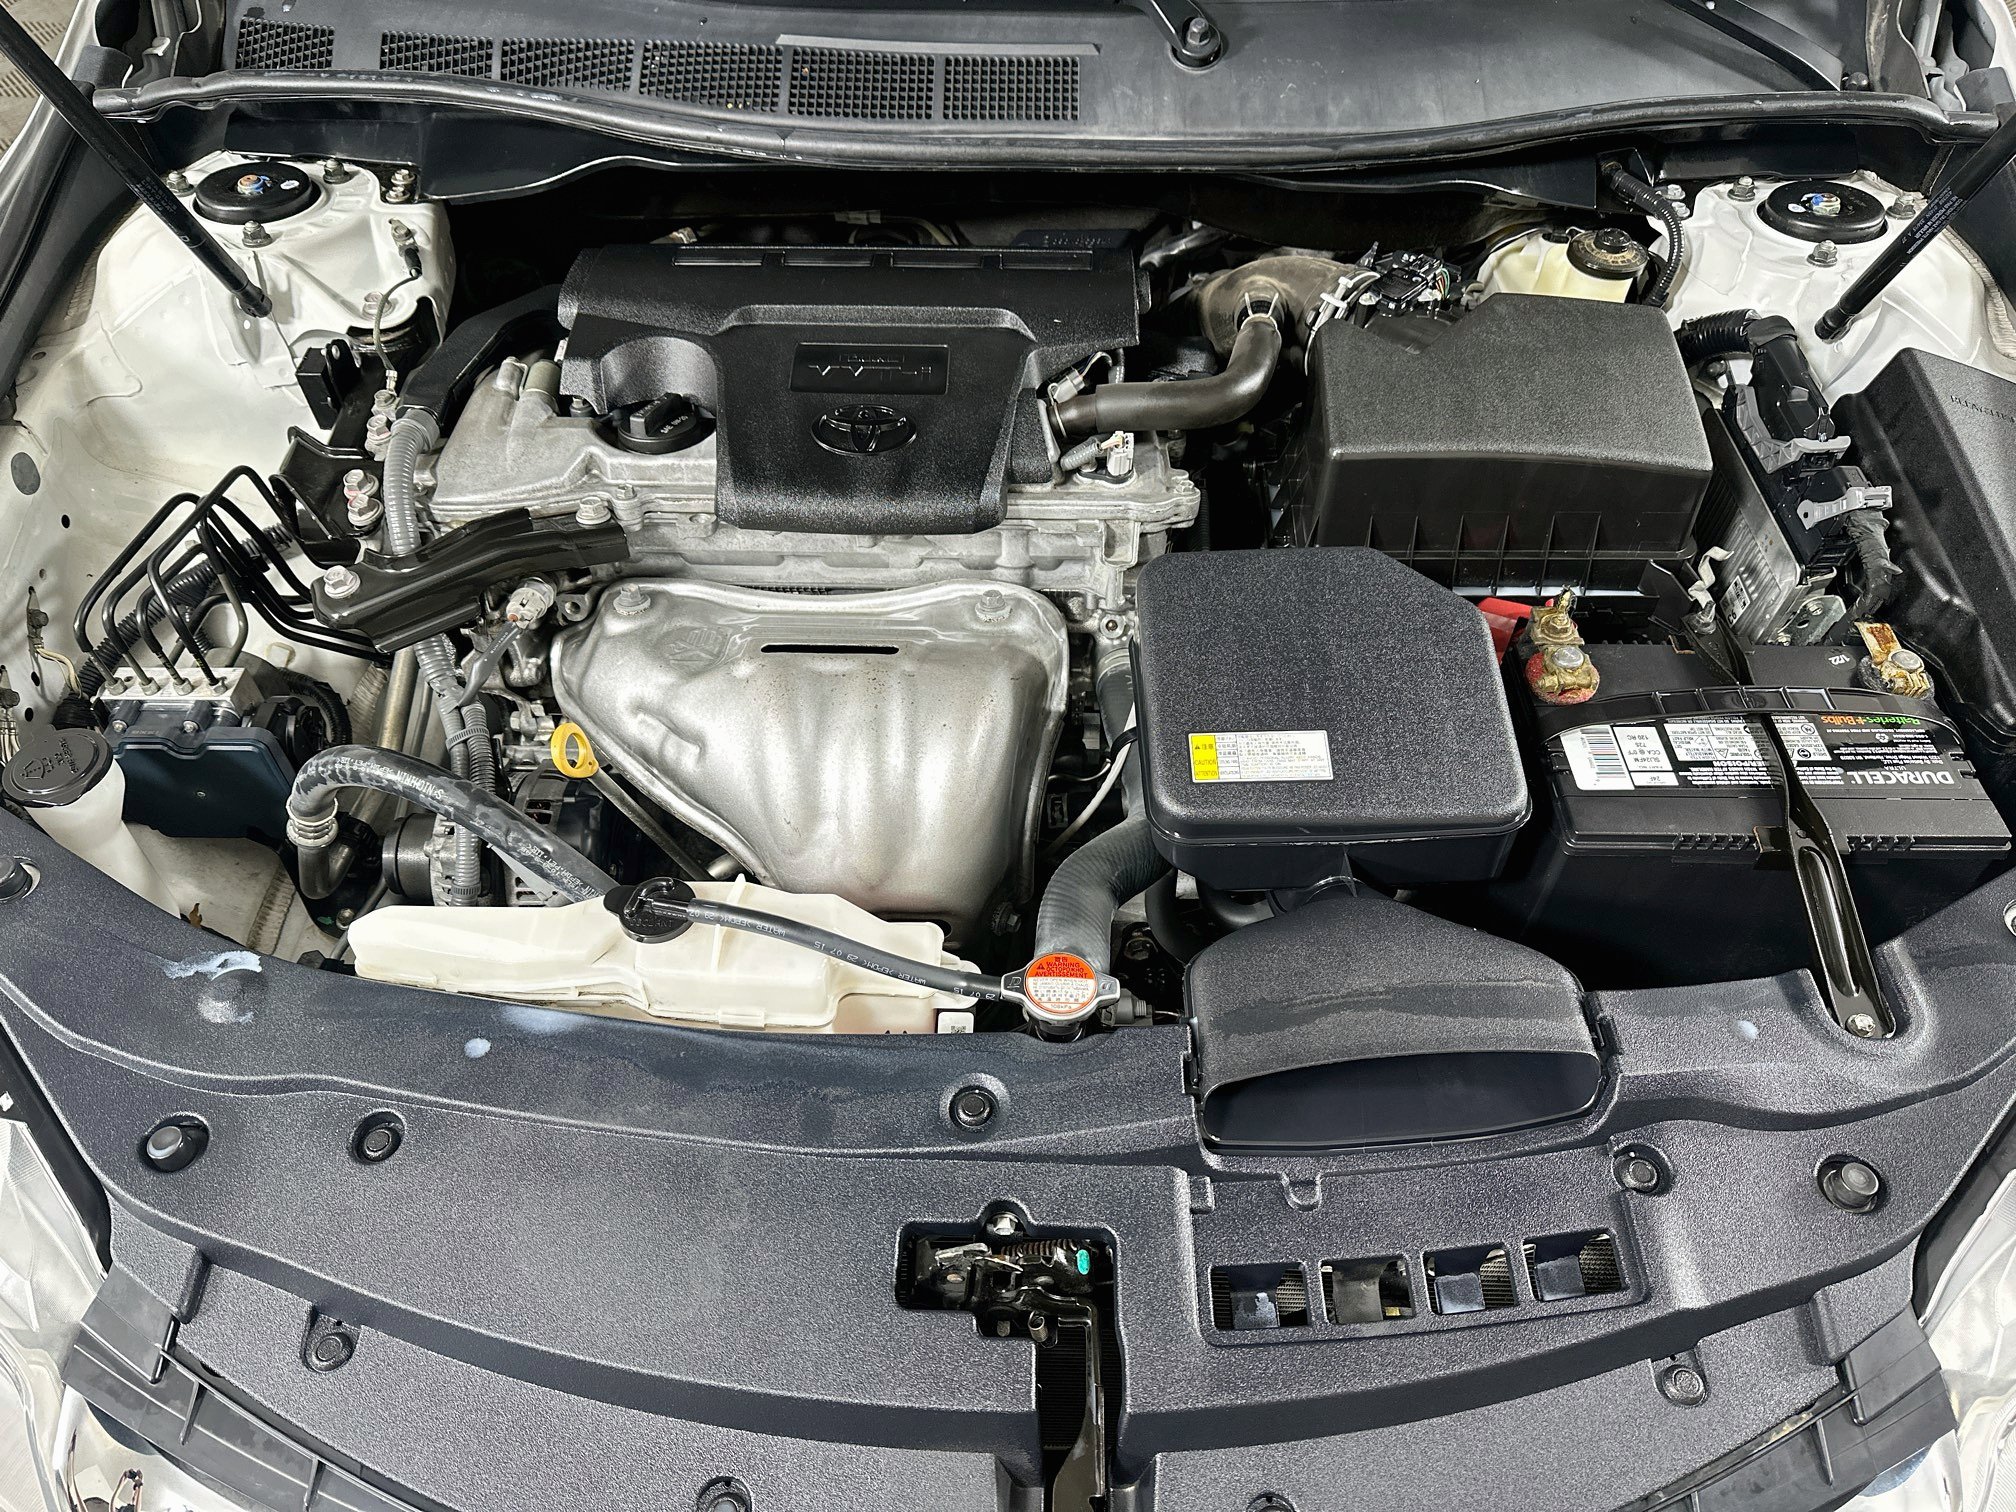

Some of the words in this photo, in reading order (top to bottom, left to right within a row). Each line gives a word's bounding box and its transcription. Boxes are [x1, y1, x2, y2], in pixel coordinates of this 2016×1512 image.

[1727, 612, 1736, 624] C6
[1847, 771, 1954, 784] DURACELL
[757, 923, 786, 936] WATER
[813, 941, 825, 950] 15
[830, 948, 843, 958] 07
[847, 953, 859, 962] 29
[898, 972, 927, 985] WATER
